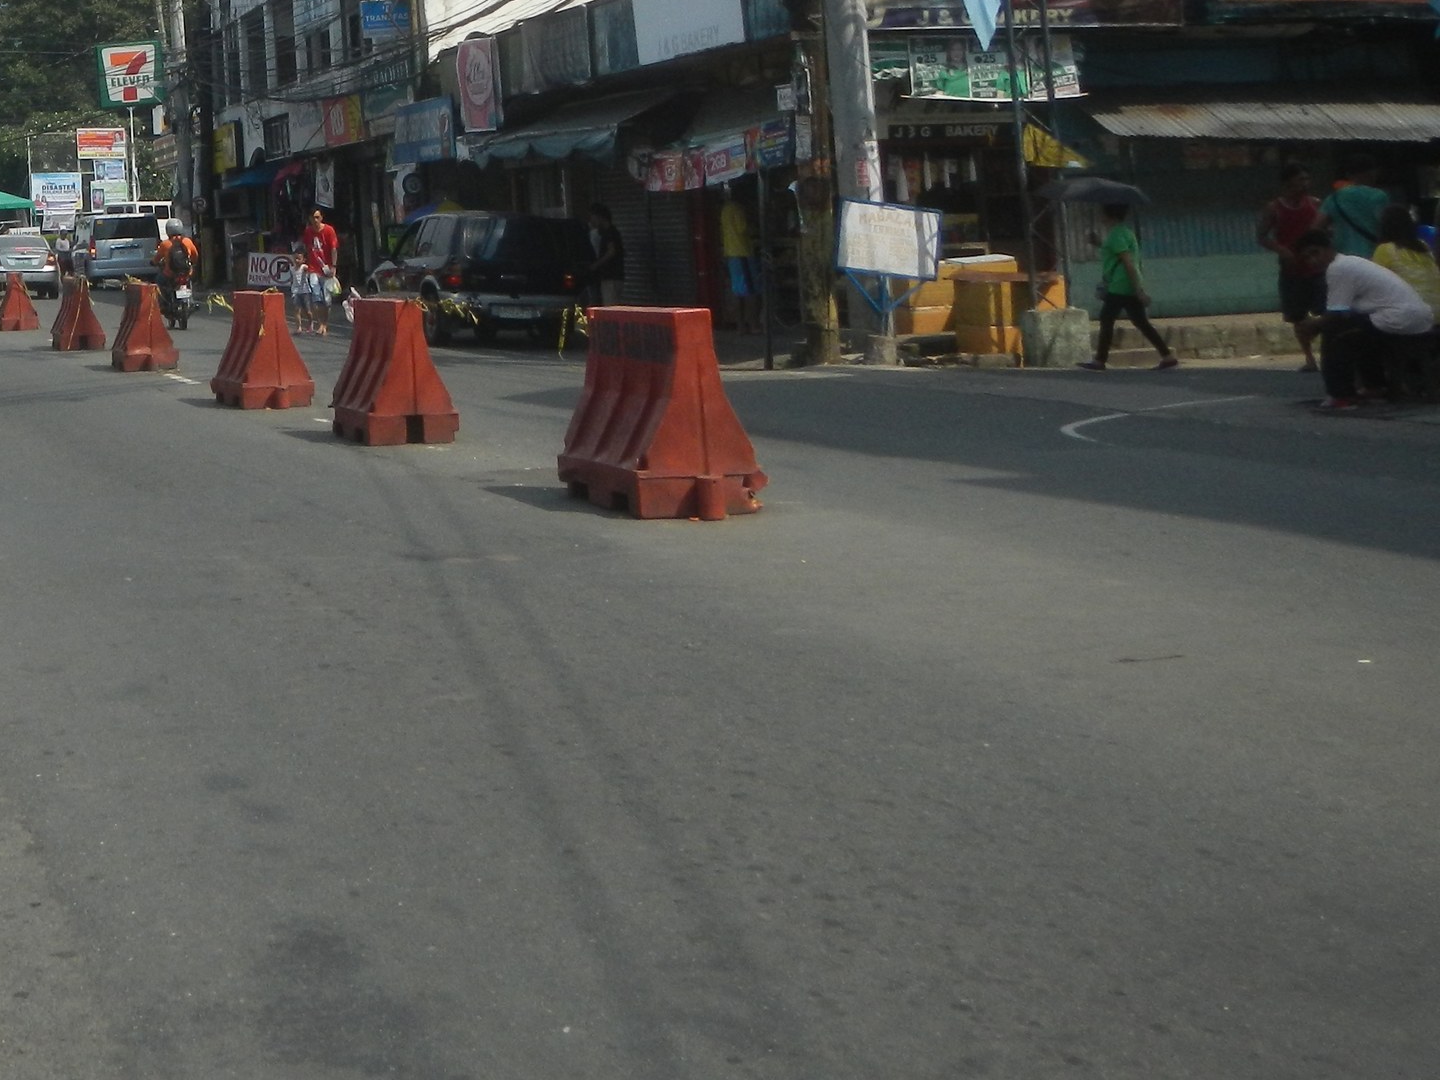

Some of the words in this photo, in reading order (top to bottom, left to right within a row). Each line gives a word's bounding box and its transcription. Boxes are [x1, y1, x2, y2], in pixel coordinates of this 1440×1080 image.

[924, 54, 937, 63] 25
[982, 54, 996, 63] 25
[945, 125, 999, 137] BAKERY
[251, 256, 268, 274] NO
